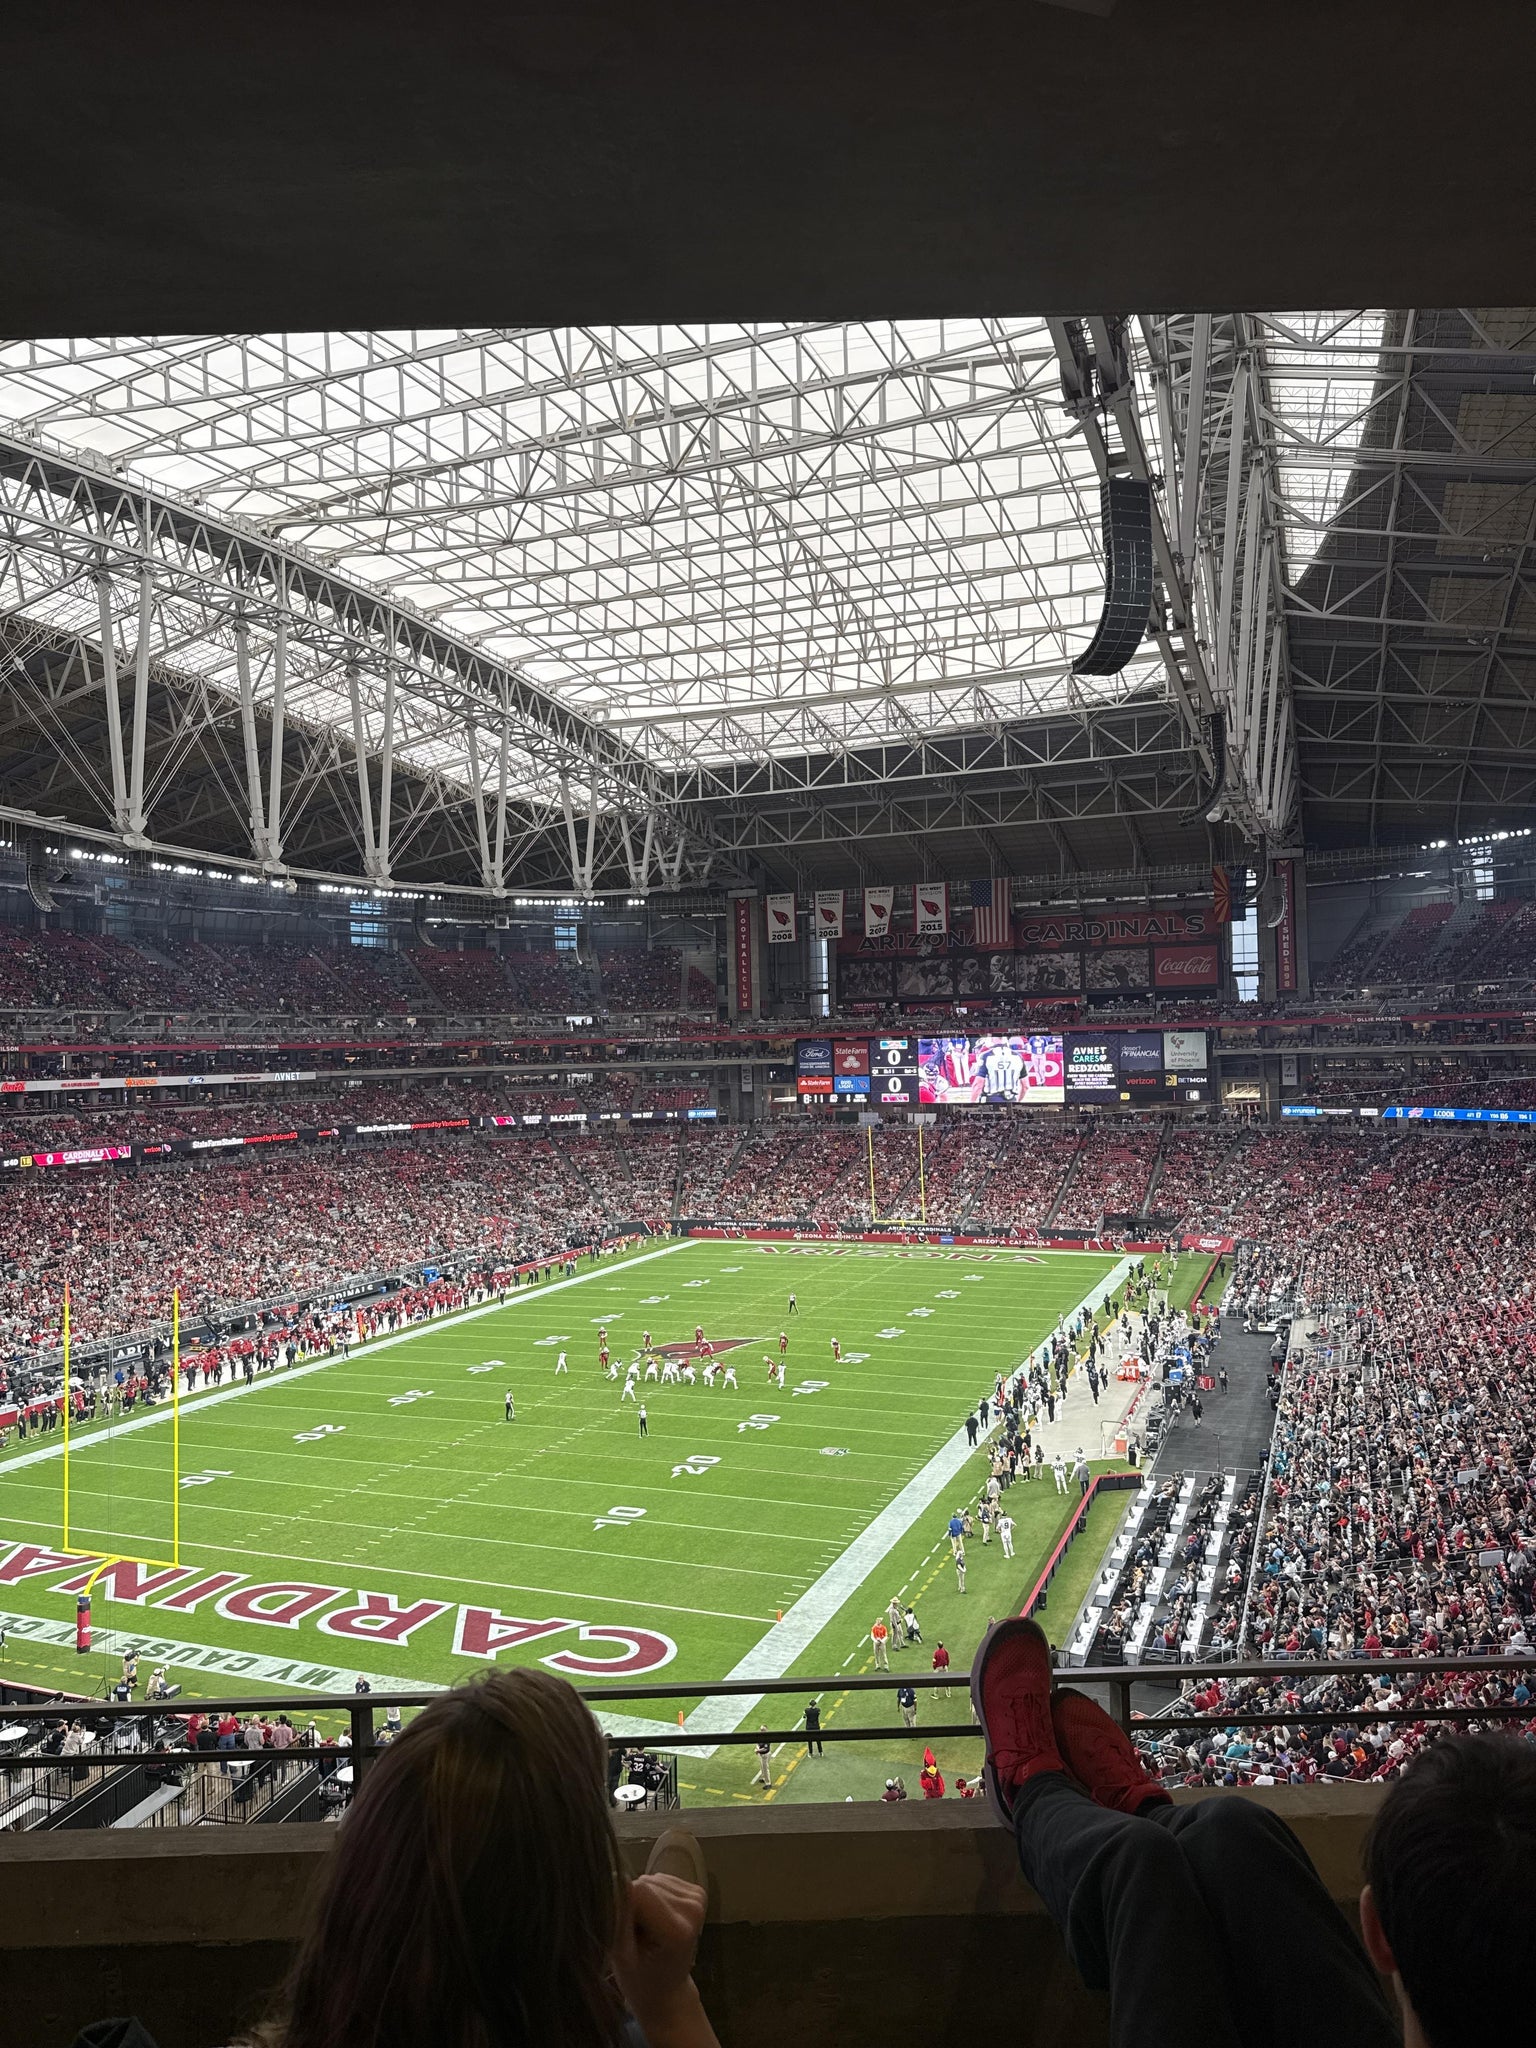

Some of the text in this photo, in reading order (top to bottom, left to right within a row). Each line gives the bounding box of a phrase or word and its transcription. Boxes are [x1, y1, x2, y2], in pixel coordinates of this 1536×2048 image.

[1022, 915, 1206, 943] CARDINALS
[1158, 955, 1214, 976] Coca-Cola
[888, 1050, 900, 1065] 0
[888, 1077, 901, 1092] 0
[803, 1094, 824, 1104] 8:11
[244, 1136, 264, 1144] powered
[46, 1154, 54, 1164] 0
[63, 1150, 104, 1160] CARDINALS
[733, 1247, 1050, 1264] ARIZONA
[840, 1353, 871, 1364] 50
[792, 1380, 830, 1395] 40
[387, 1389, 435, 1406] 30
[737, 1413, 781, 1431] 30
[292, 1424, 346, 1442] 20
[671, 1455, 722, 1476] 20
[179, 1469, 234, 1487] 10
[592, 1505, 648, 1527] 10
[0, 1540, 678, 1676] CARDINA
[113, 1639, 260, 1672] CAUSE
[264, 1666, 339, 1687] MY
[633, 1762, 644, 1772] 32
